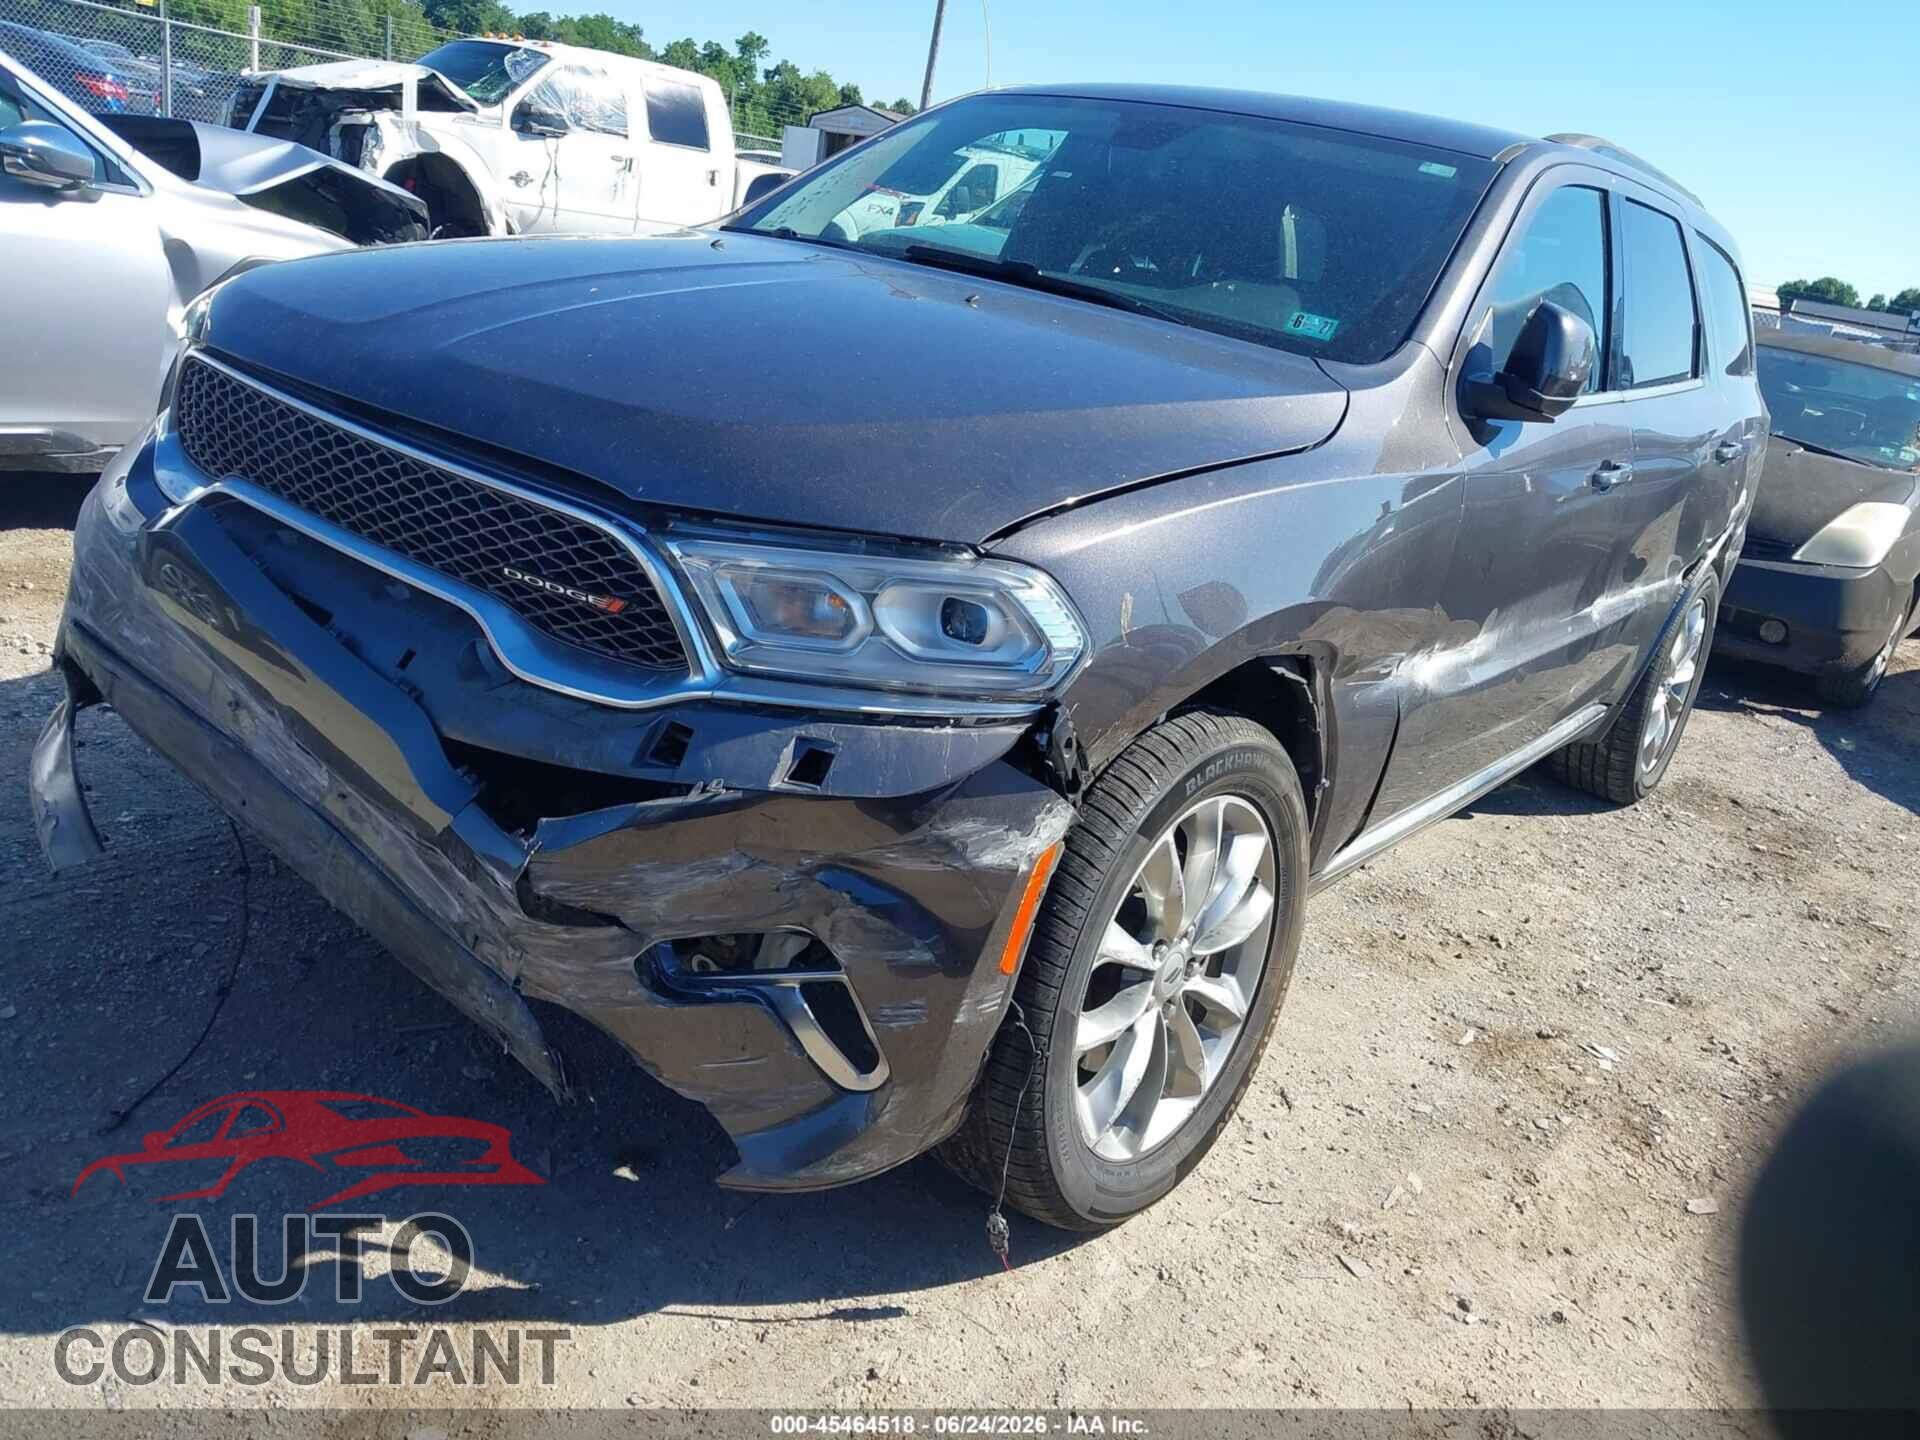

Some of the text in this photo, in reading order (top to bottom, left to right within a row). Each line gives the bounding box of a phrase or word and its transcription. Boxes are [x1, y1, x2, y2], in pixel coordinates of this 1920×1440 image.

[1292, 314, 1304, 329] 6
[503, 567, 609, 609] DODGE
[1184, 752, 1265, 796] BLACKHAW
